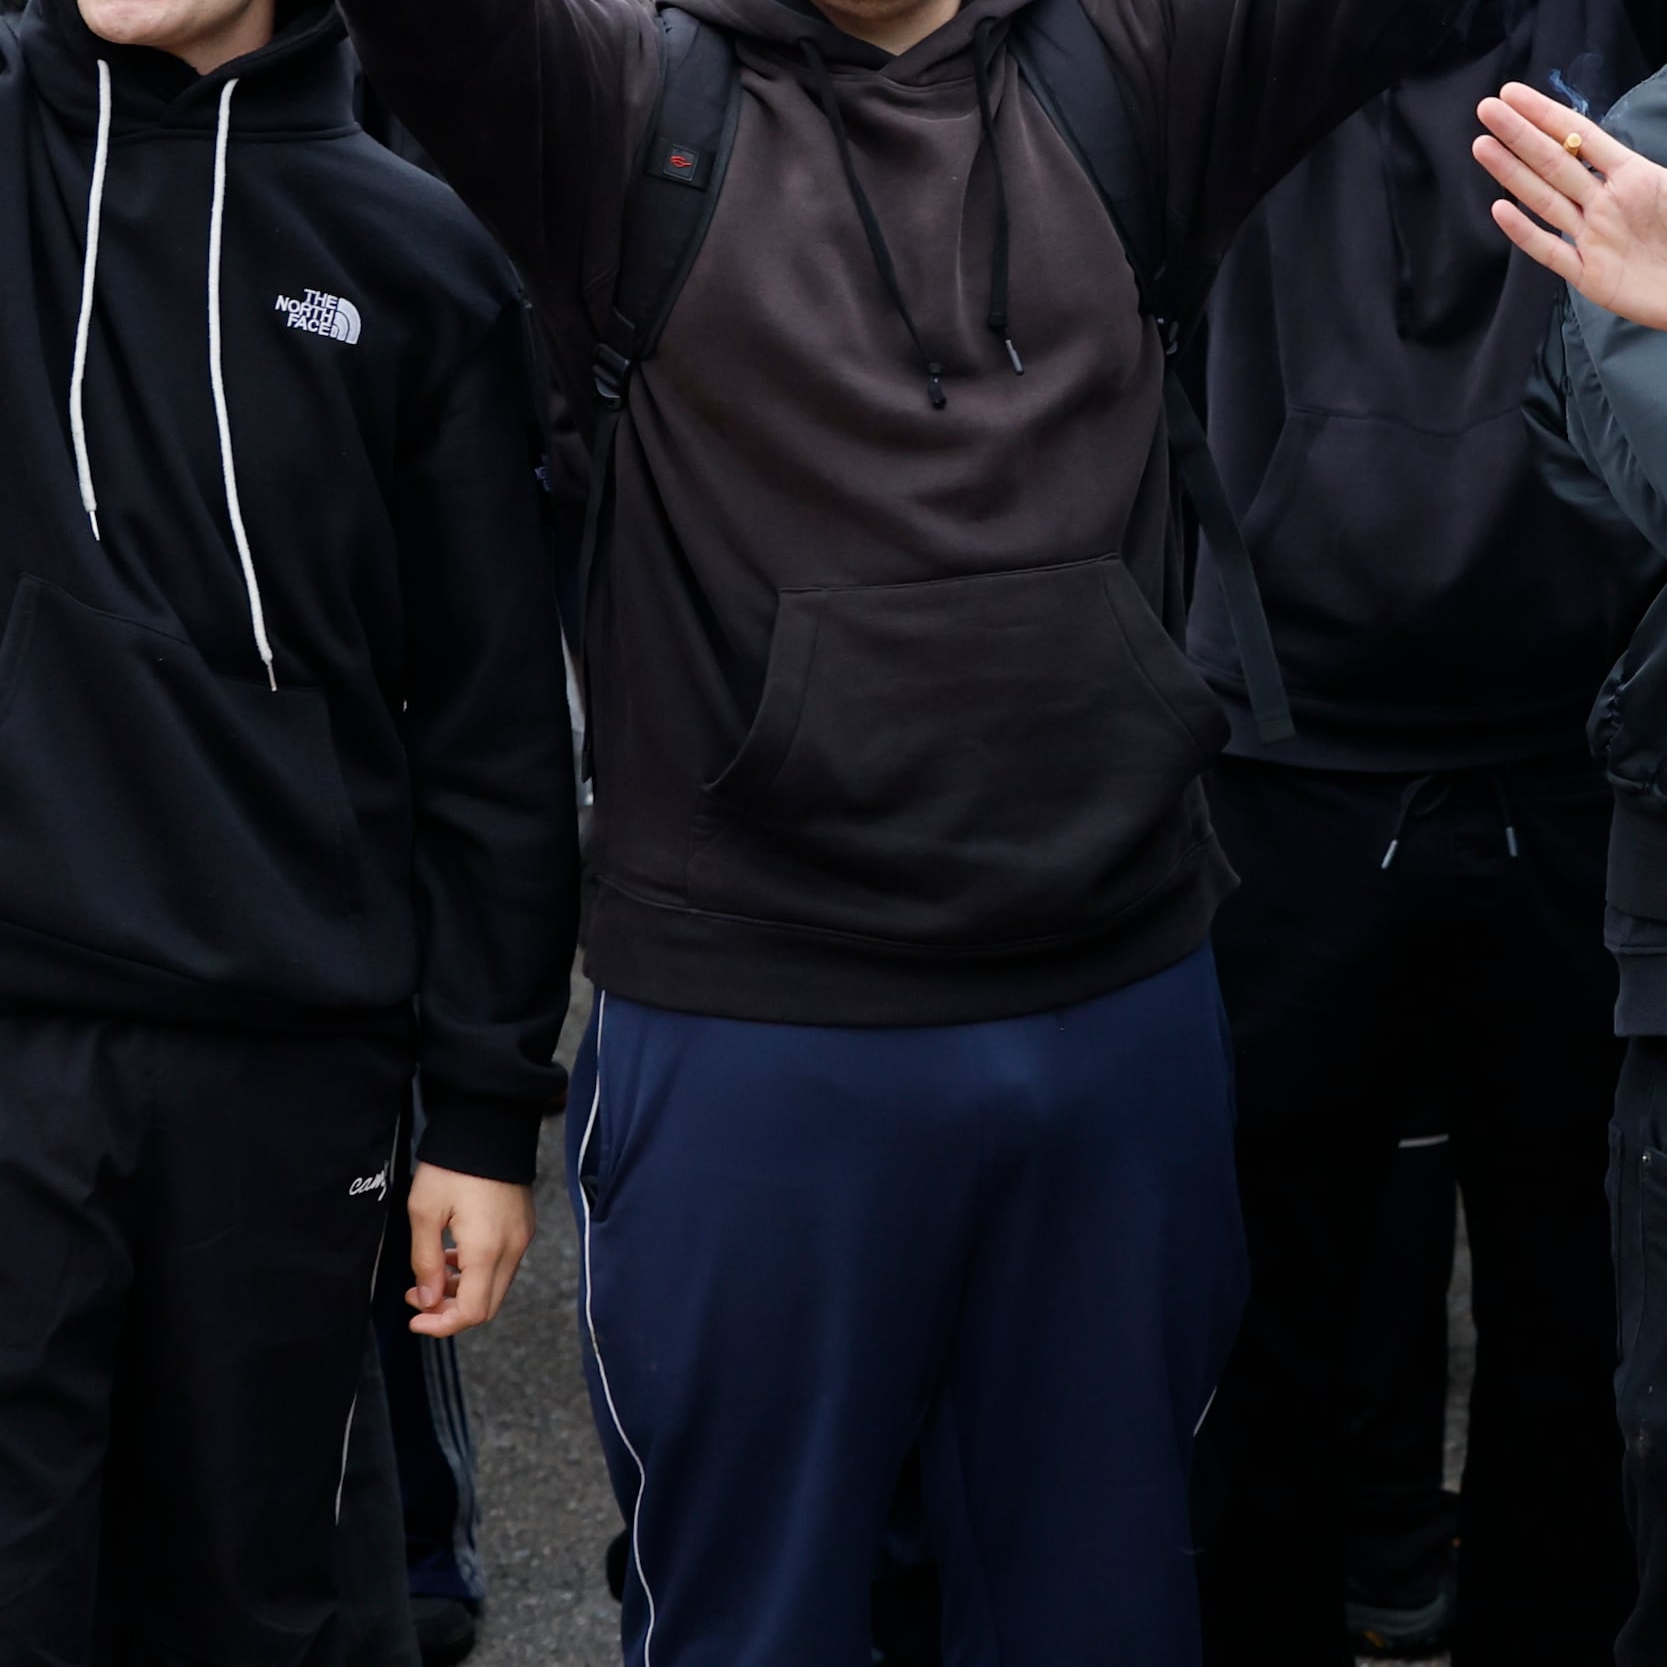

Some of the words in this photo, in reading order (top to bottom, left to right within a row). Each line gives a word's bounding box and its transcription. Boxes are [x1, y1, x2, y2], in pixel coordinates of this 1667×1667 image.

[275, 294, 335, 327] NORTH
[303, 288, 339, 310] THE
[286, 313, 332, 336] FACE
